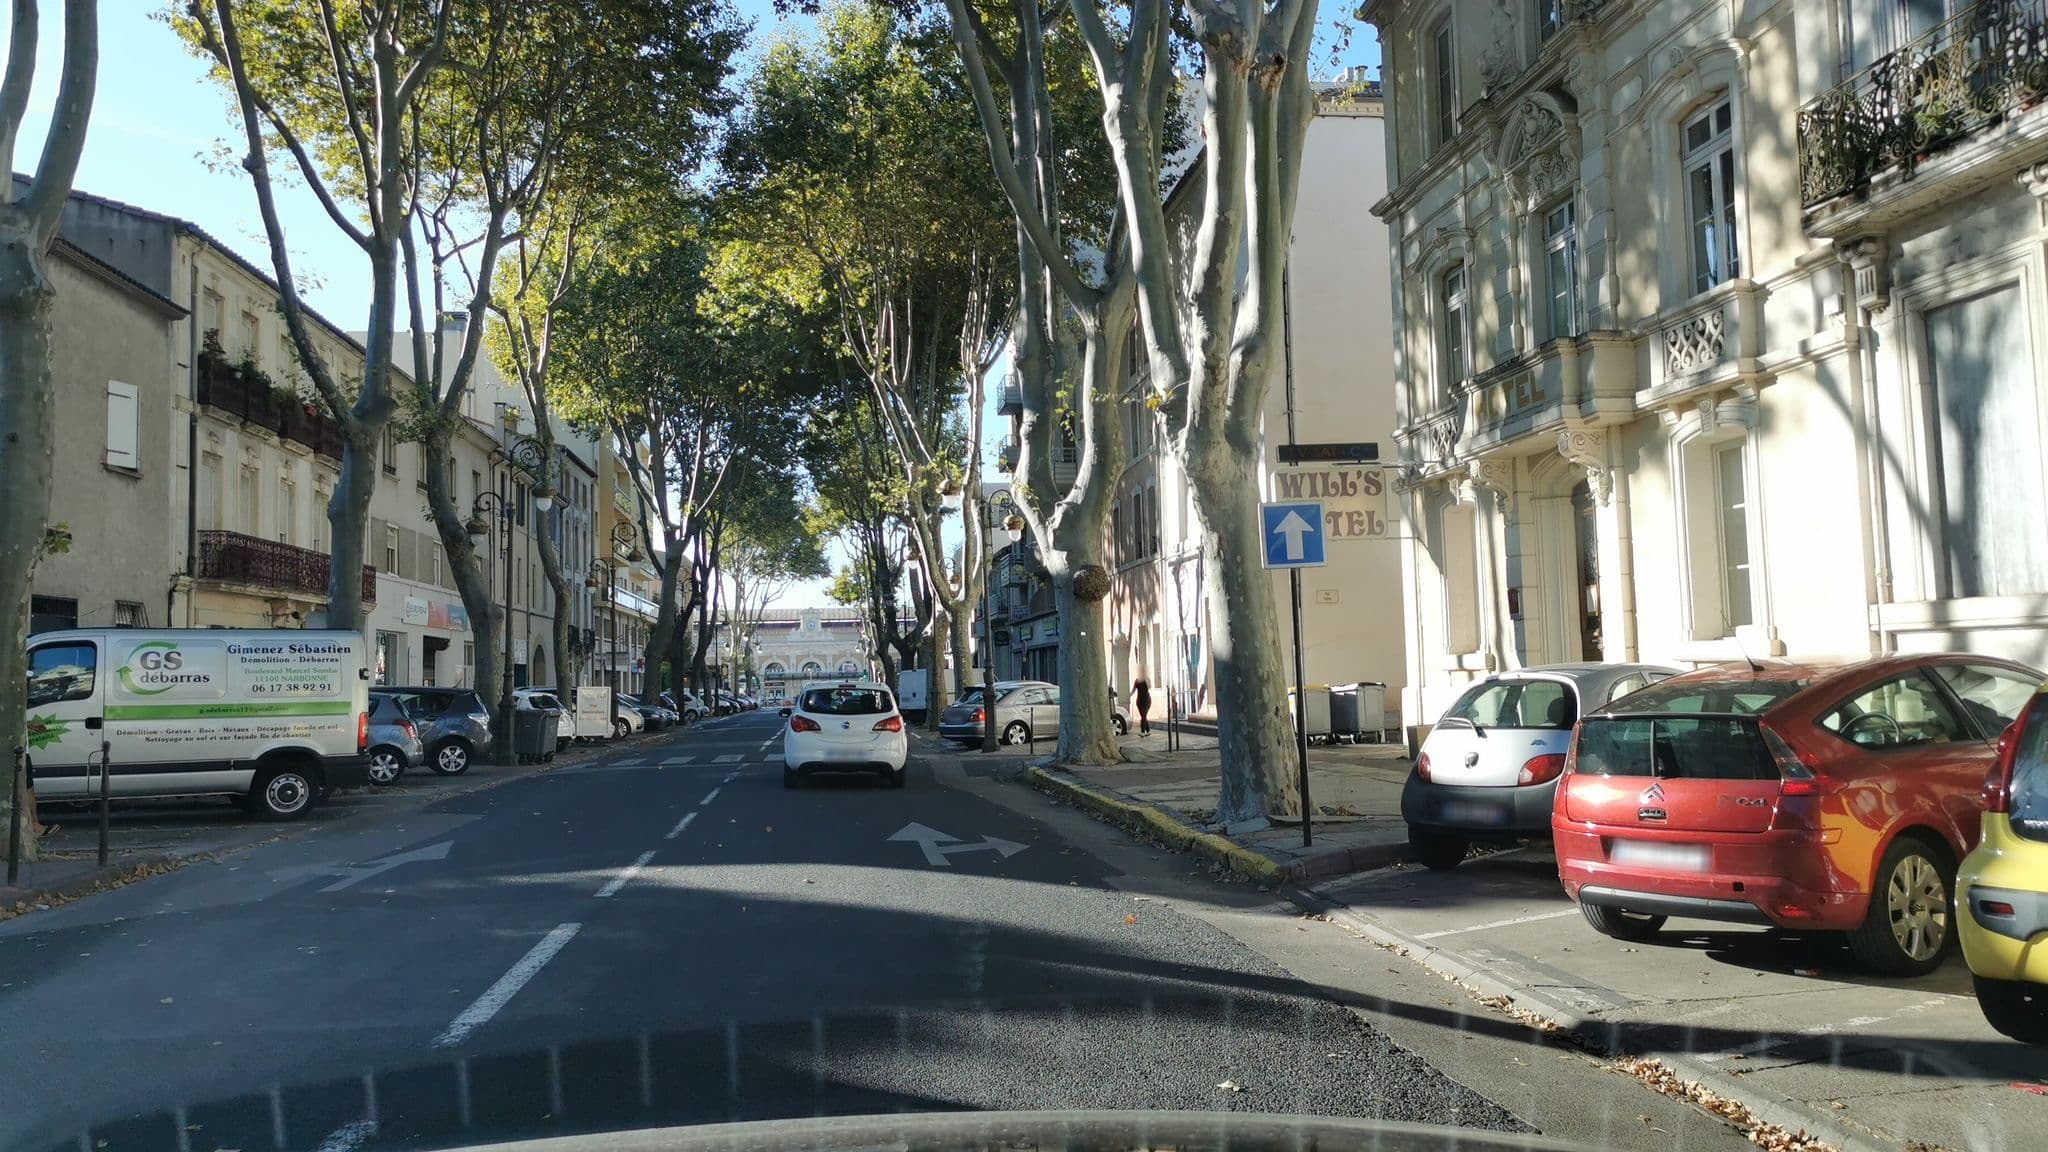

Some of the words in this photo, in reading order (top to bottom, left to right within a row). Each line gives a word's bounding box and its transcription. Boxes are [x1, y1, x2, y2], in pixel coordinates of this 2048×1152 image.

[1277, 470, 1383, 498] WILL'S
[1325, 510, 1385, 537] TEL
[227, 644, 284, 654] Gimenez
[288, 643, 351, 654] Sébastien
[140, 651, 183, 671] GS
[240, 656, 290, 664] Démolition
[140, 671, 210, 683] débarras
[281, 674, 329, 682] NARBONNE
[252, 684, 265, 693] 06
[270, 684, 282, 692] 17
[286, 683, 299, 692] 38
[303, 683, 316, 692] 92
[320, 683, 331, 692] 91
[257, 725, 291, 733] Décapage
[144, 736, 183, 744] Nettoyage
[234, 733, 257, 741] façade
